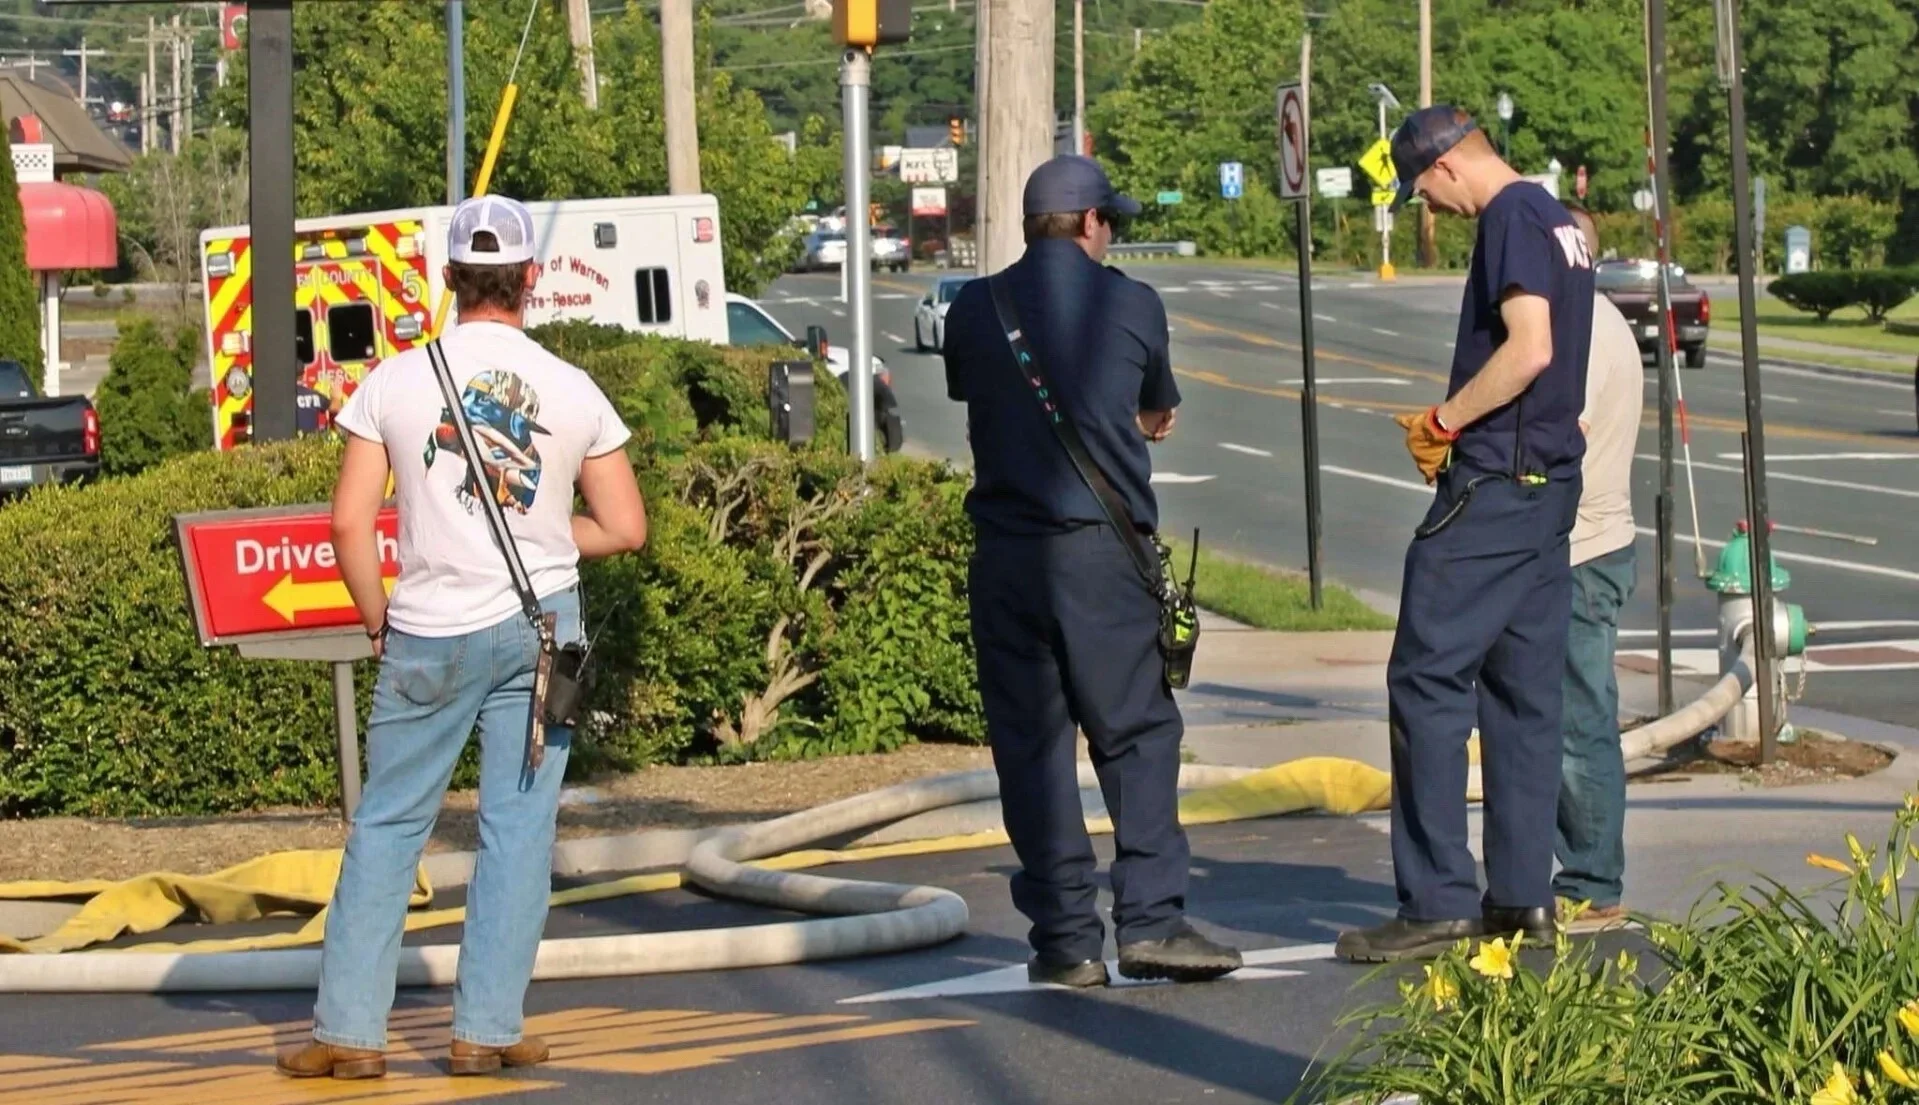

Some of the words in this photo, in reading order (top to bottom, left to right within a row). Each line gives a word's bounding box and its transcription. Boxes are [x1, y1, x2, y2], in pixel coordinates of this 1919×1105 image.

[906, 161, 927, 169] KFC
[320, 268, 373, 286] COUNTY
[550, 256, 562, 272] of
[569, 256, 609, 291] Warren
[402, 269, 422, 303] 5
[524, 292, 592, 309] Fire-Rescue
[297, 395, 320, 408] CFR
